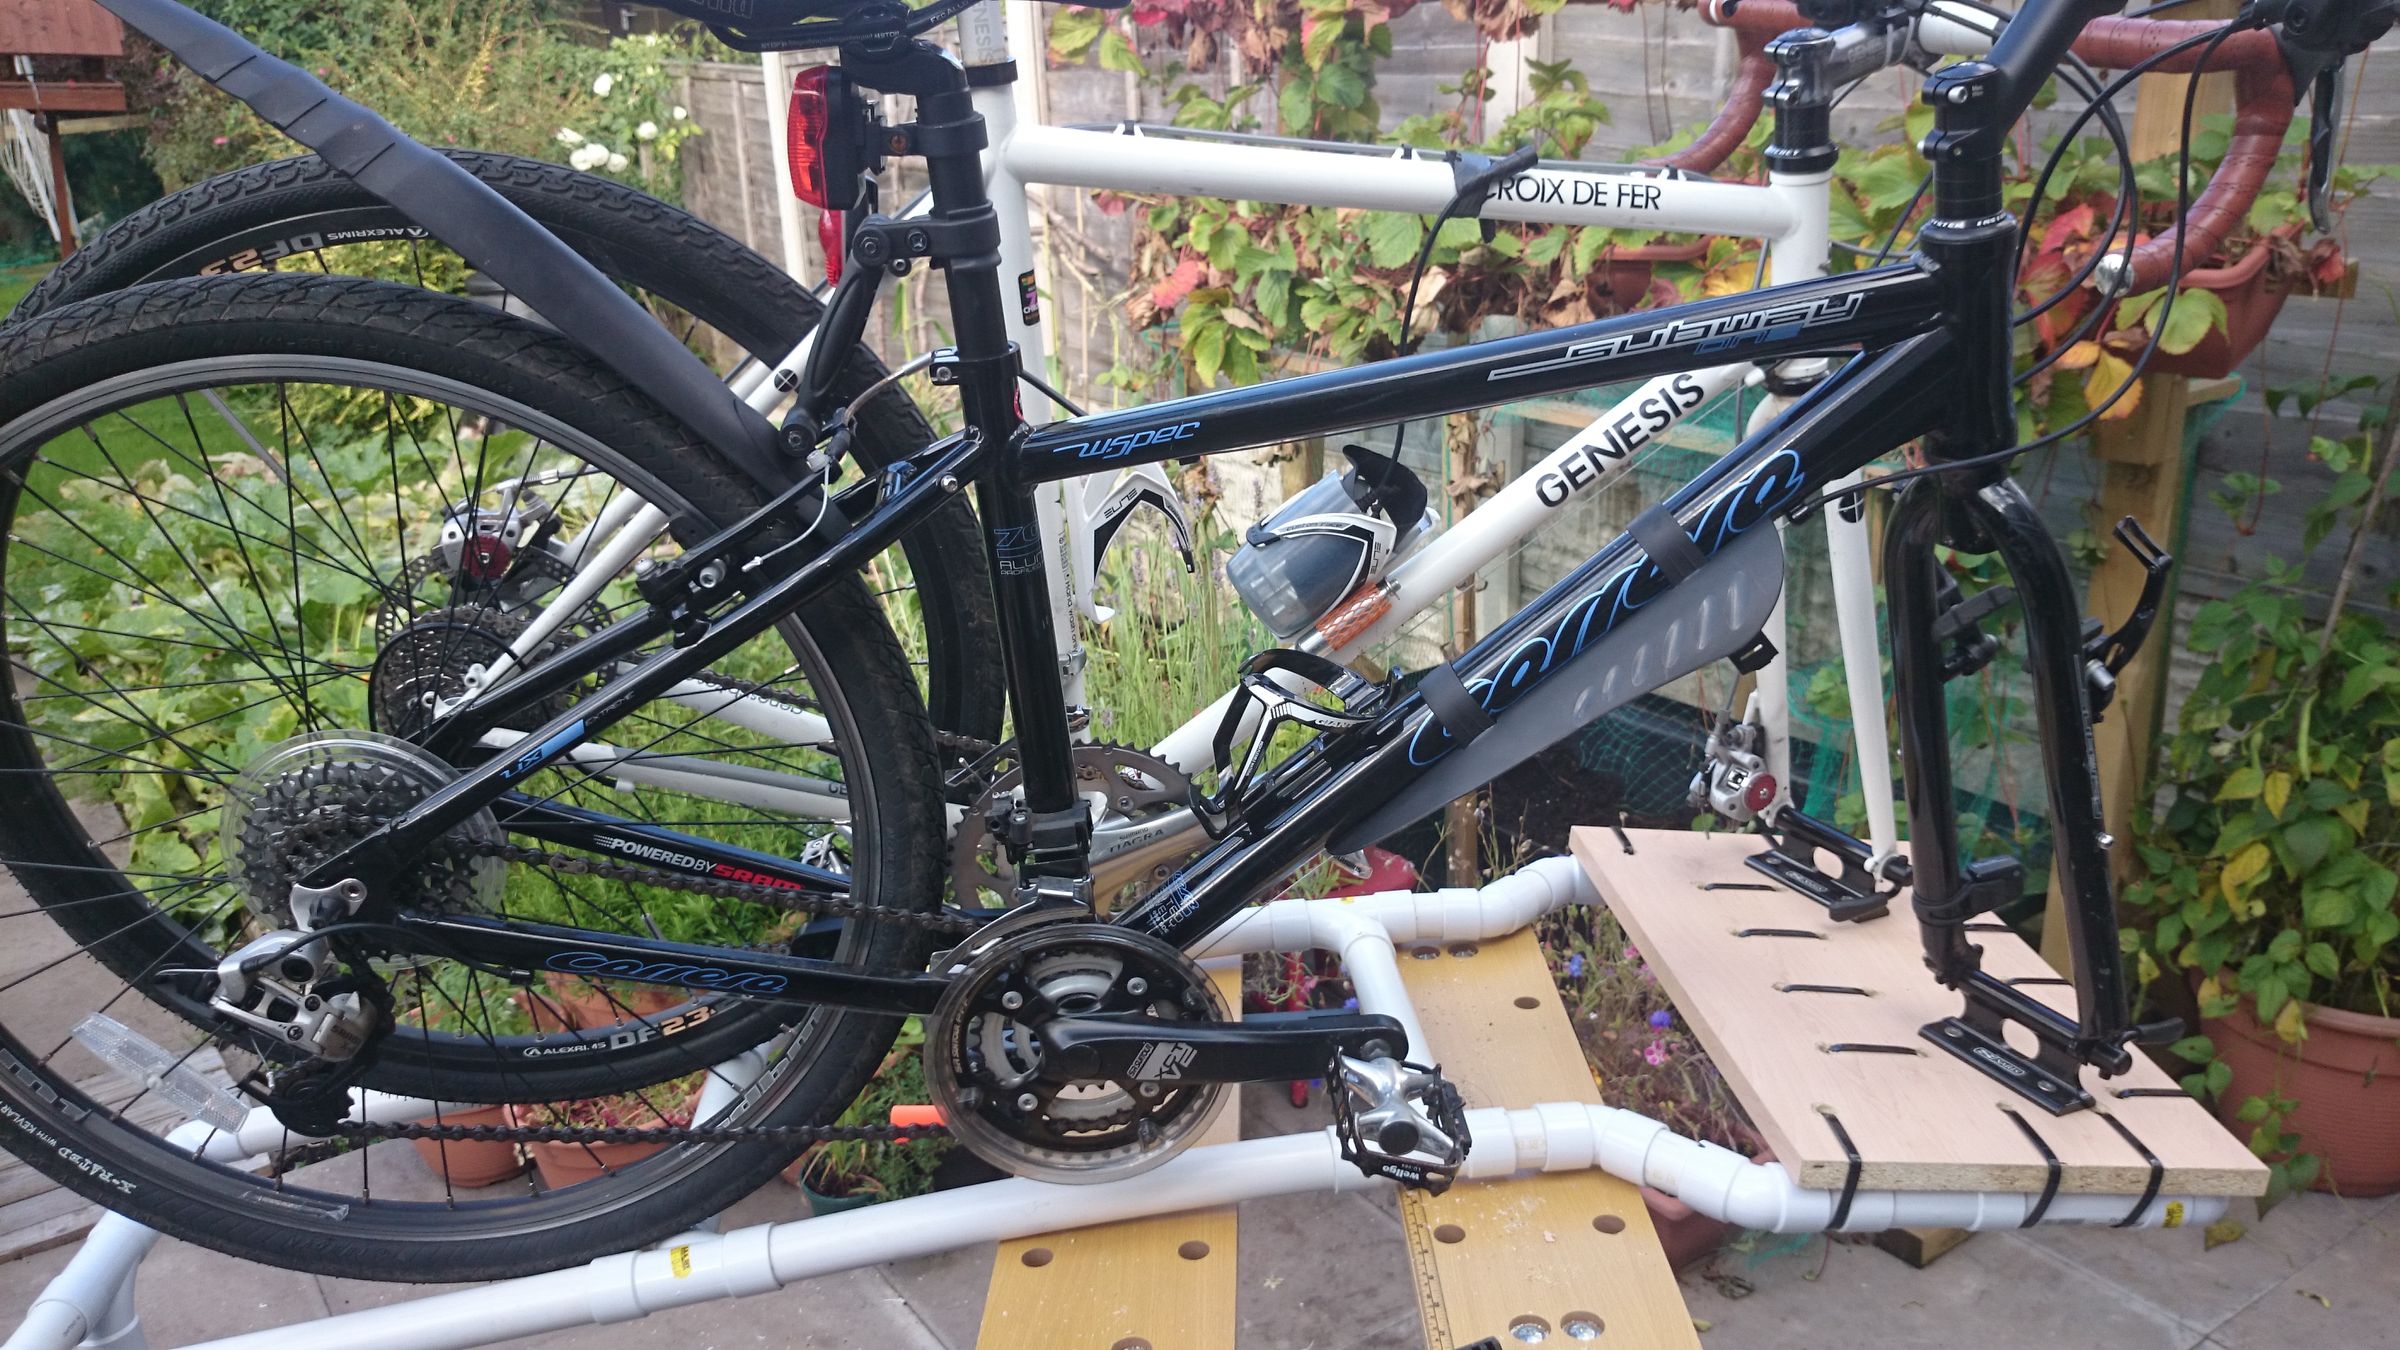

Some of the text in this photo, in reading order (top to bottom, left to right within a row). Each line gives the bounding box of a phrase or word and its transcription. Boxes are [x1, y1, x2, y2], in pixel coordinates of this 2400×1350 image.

[1486, 176, 1661, 210] ROIX DE FER
[327, 228, 401, 241] ALEXRIMS
[1535, 373, 1704, 508] GENESIS
[1108, 829, 1164, 853] TIAGRA
[0, 1104, 137, 1194] X-RATED WITH KEVLAR
[1381, 1164, 1420, 1181] wellgo
